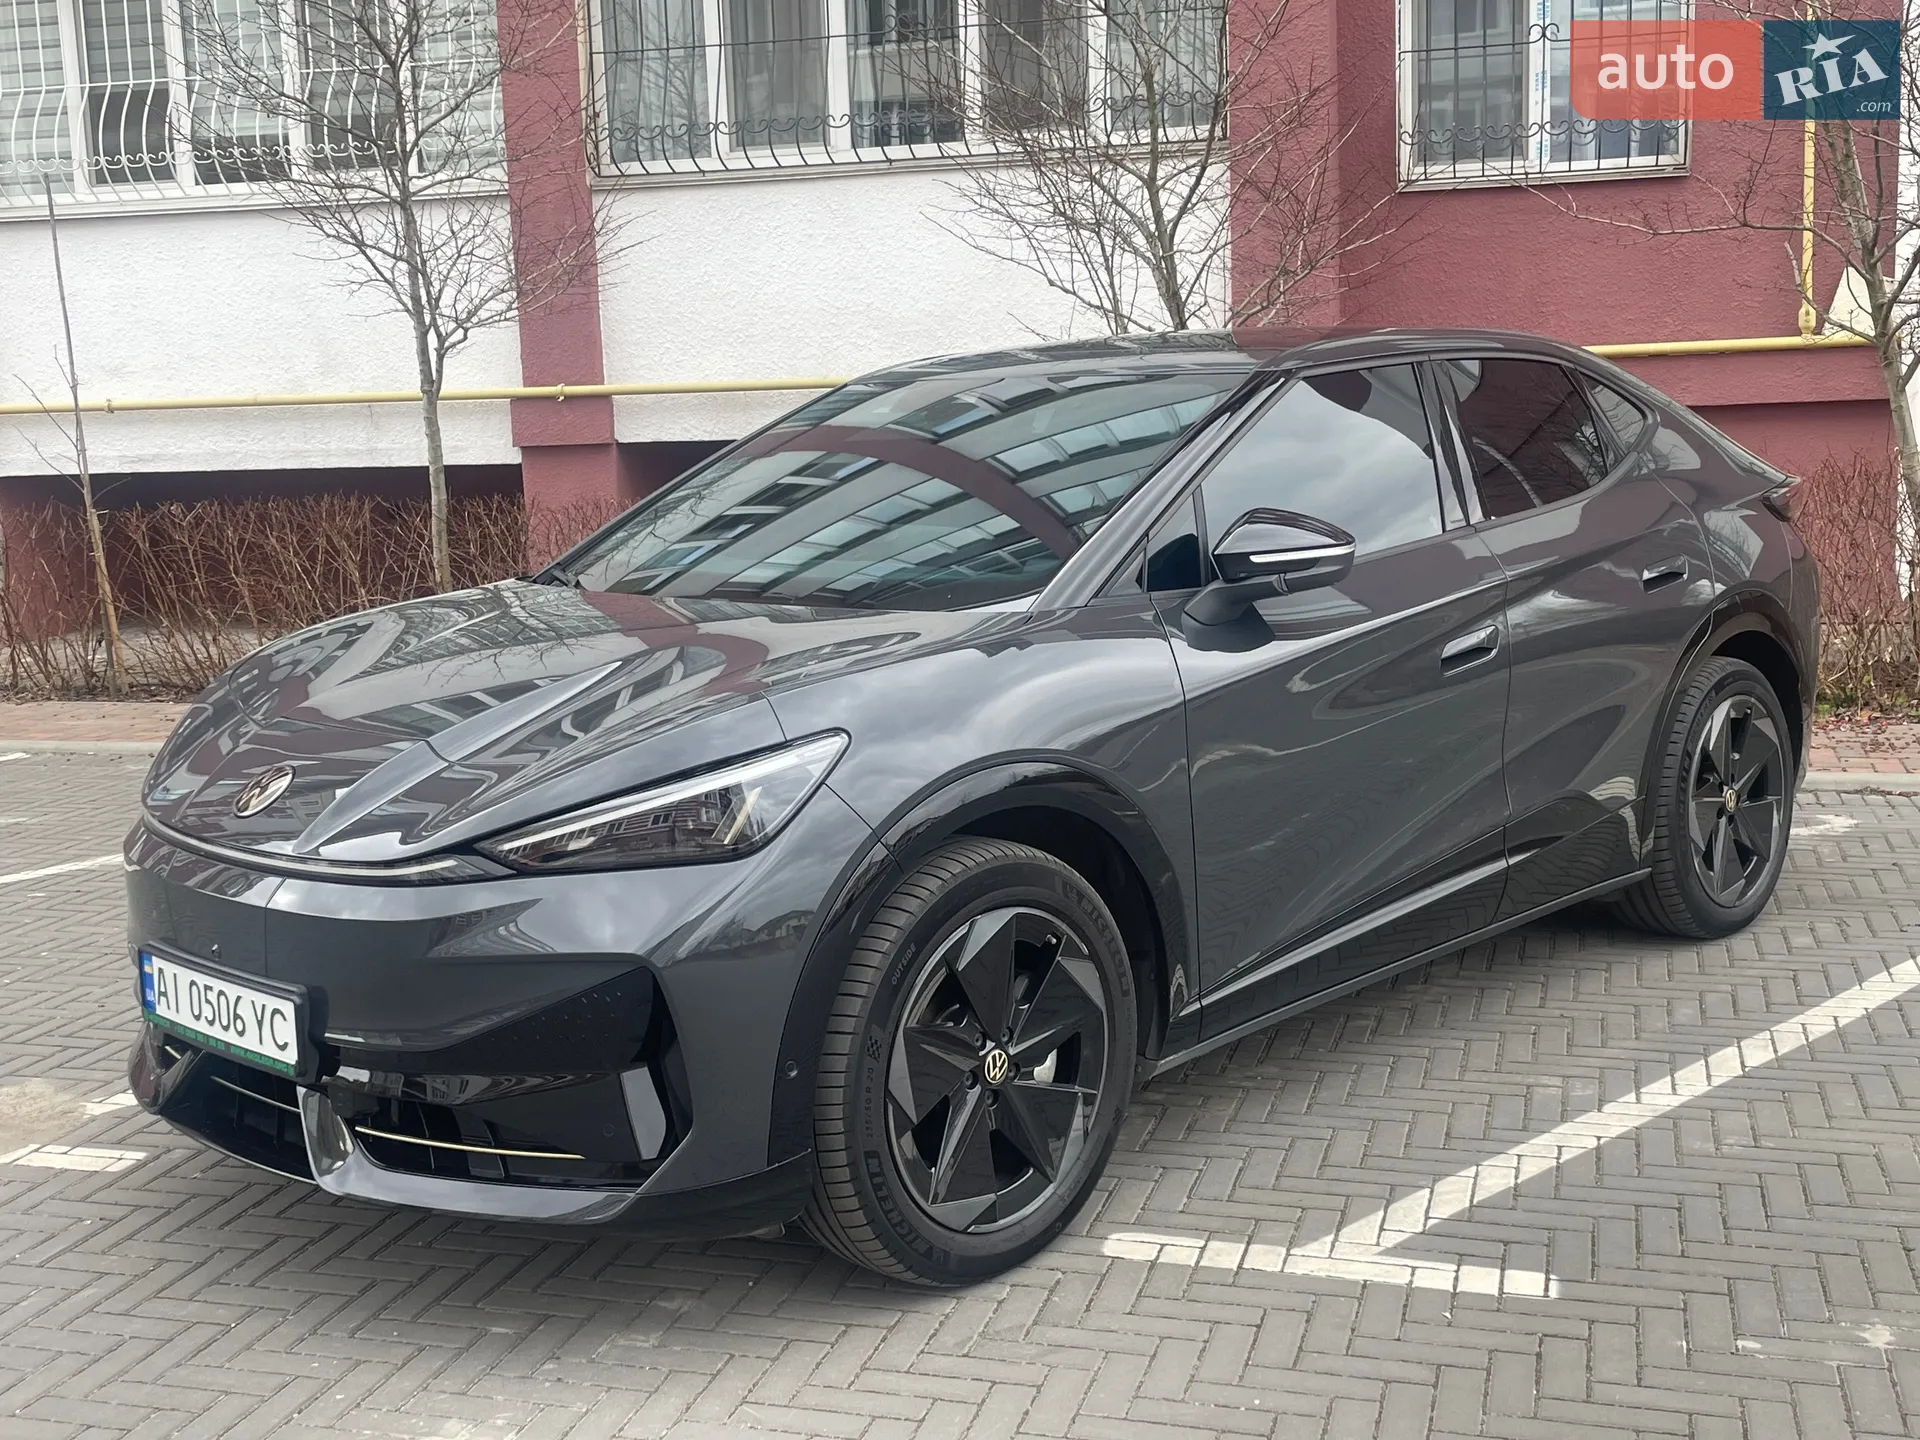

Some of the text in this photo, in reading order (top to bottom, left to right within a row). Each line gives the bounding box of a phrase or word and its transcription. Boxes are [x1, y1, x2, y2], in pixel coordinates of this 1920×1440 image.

[891, 942, 917, 985] OUTSIDE
[157, 966, 180, 1014] AI
[188, 979, 247, 1038] 0506
[250, 999, 289, 1052] YC
[985, 1049, 1008, 1084] VW
[867, 1157, 931, 1256] MICHELIN
